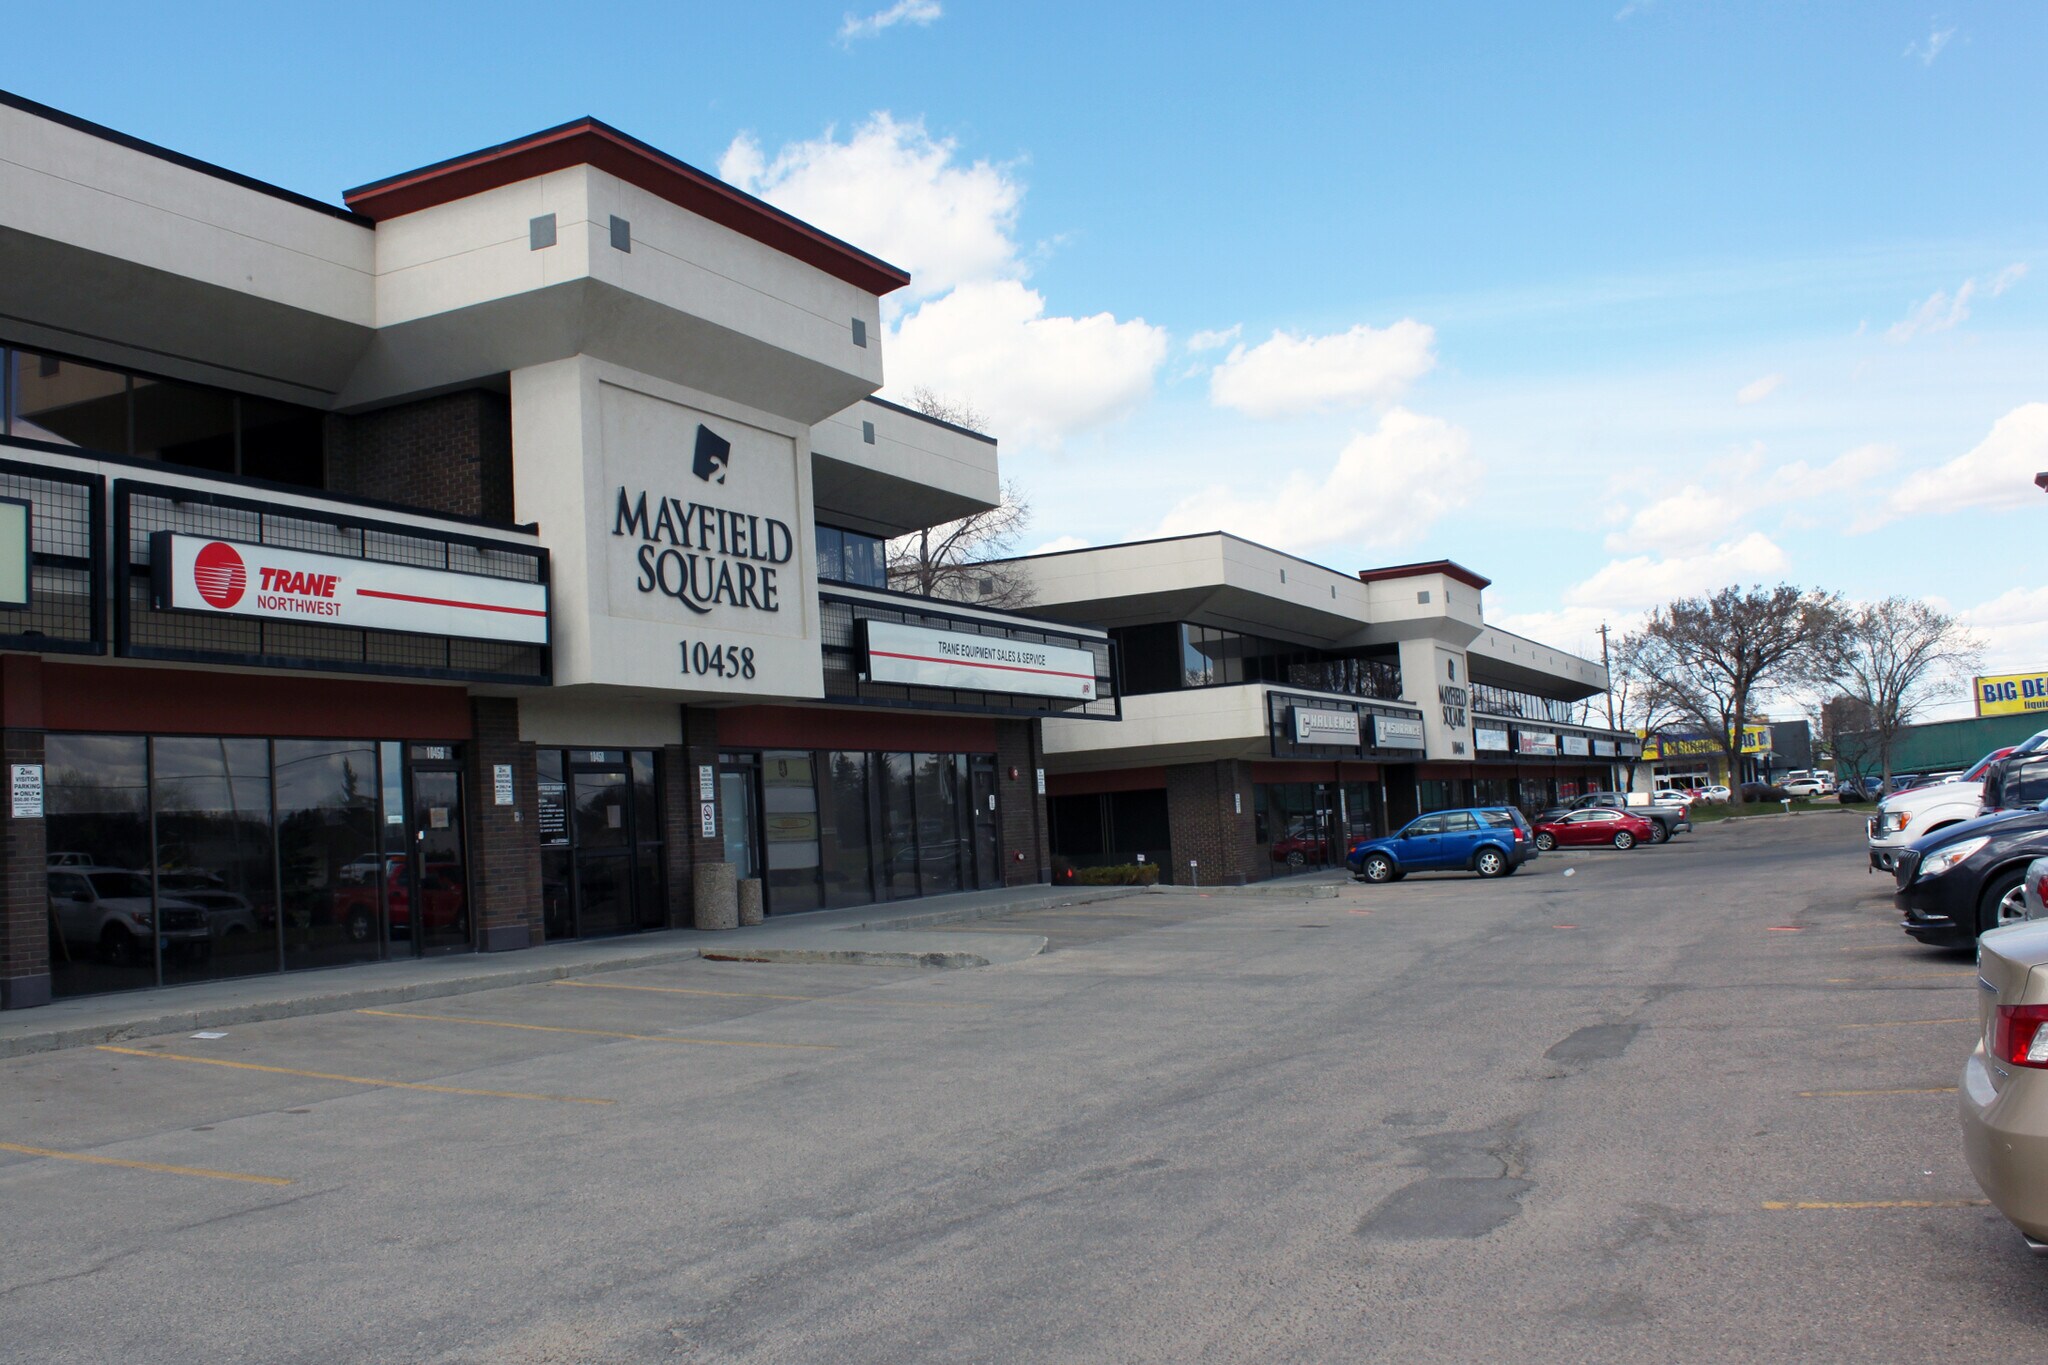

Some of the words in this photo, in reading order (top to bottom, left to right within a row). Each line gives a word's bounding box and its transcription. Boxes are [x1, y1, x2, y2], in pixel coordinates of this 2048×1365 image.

[612, 486, 793, 564] MAYFIELD
[259, 567, 338, 598] TRANE
[637, 544, 780, 614] SQUARE
[257, 595, 342, 616] NORTHWEST
[680, 639, 756, 680] 10458
[938, 641, 961, 656] TRANE
[961, 644, 996, 661] EQUIPMENT
[997, 648, 1016, 663] SALES
[1016, 651, 1022, 664] &
[1022, 651, 1046, 666] SERVICE
[1983, 682, 2017, 703] BIG
[2021, 678, 2048, 698] DE
[1299, 713, 1356, 738] CHALLENGE
[1442, 705, 1466, 731] SQUARE
[1379, 721, 1421, 743] INSURANCE
